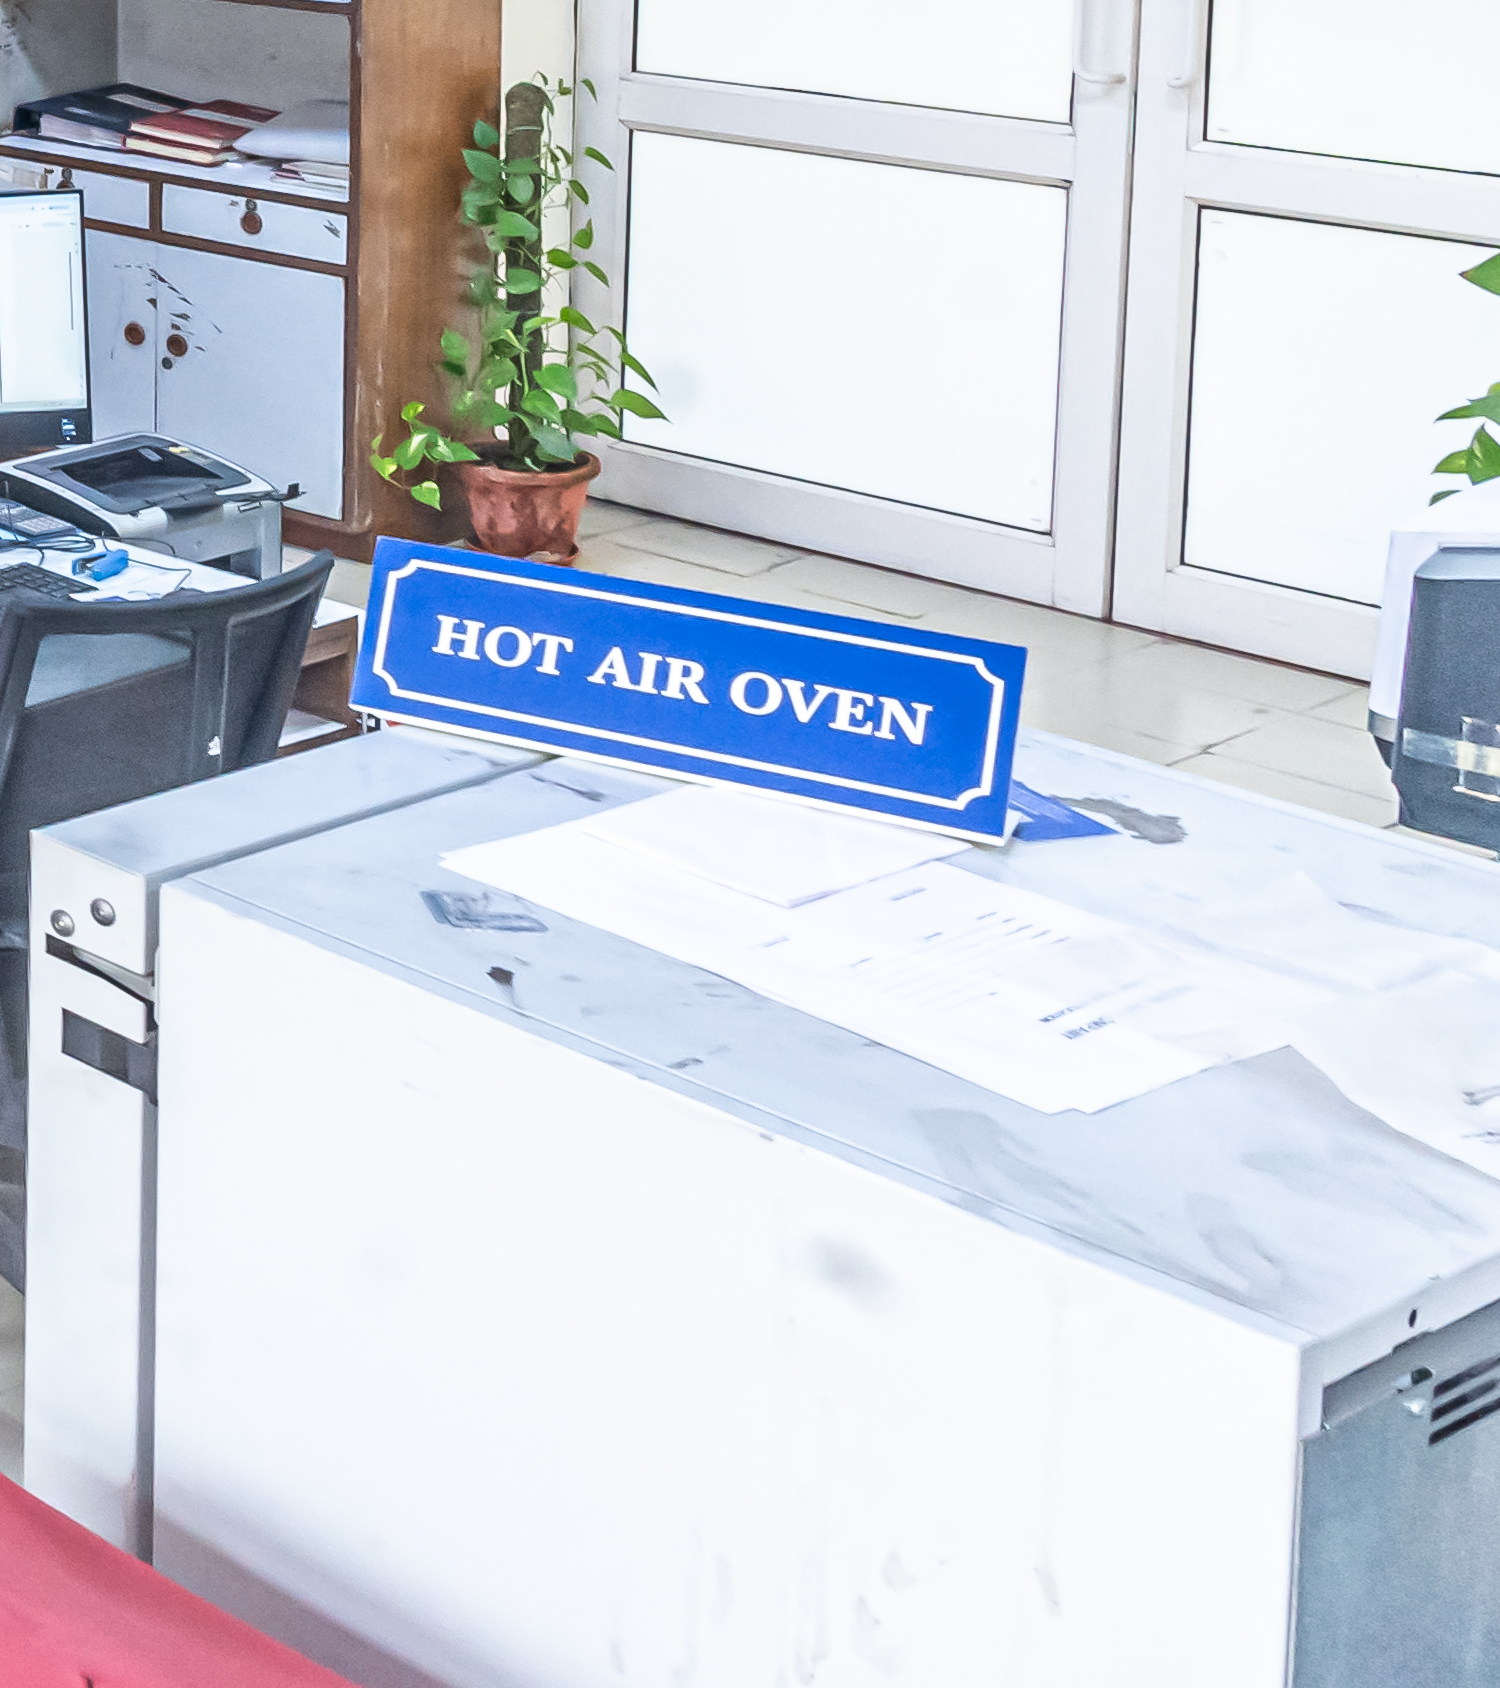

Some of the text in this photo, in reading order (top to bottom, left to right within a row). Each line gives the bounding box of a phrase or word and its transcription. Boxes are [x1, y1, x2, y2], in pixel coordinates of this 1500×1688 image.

[431, 614, 933, 746] HOT AIR OVEN
